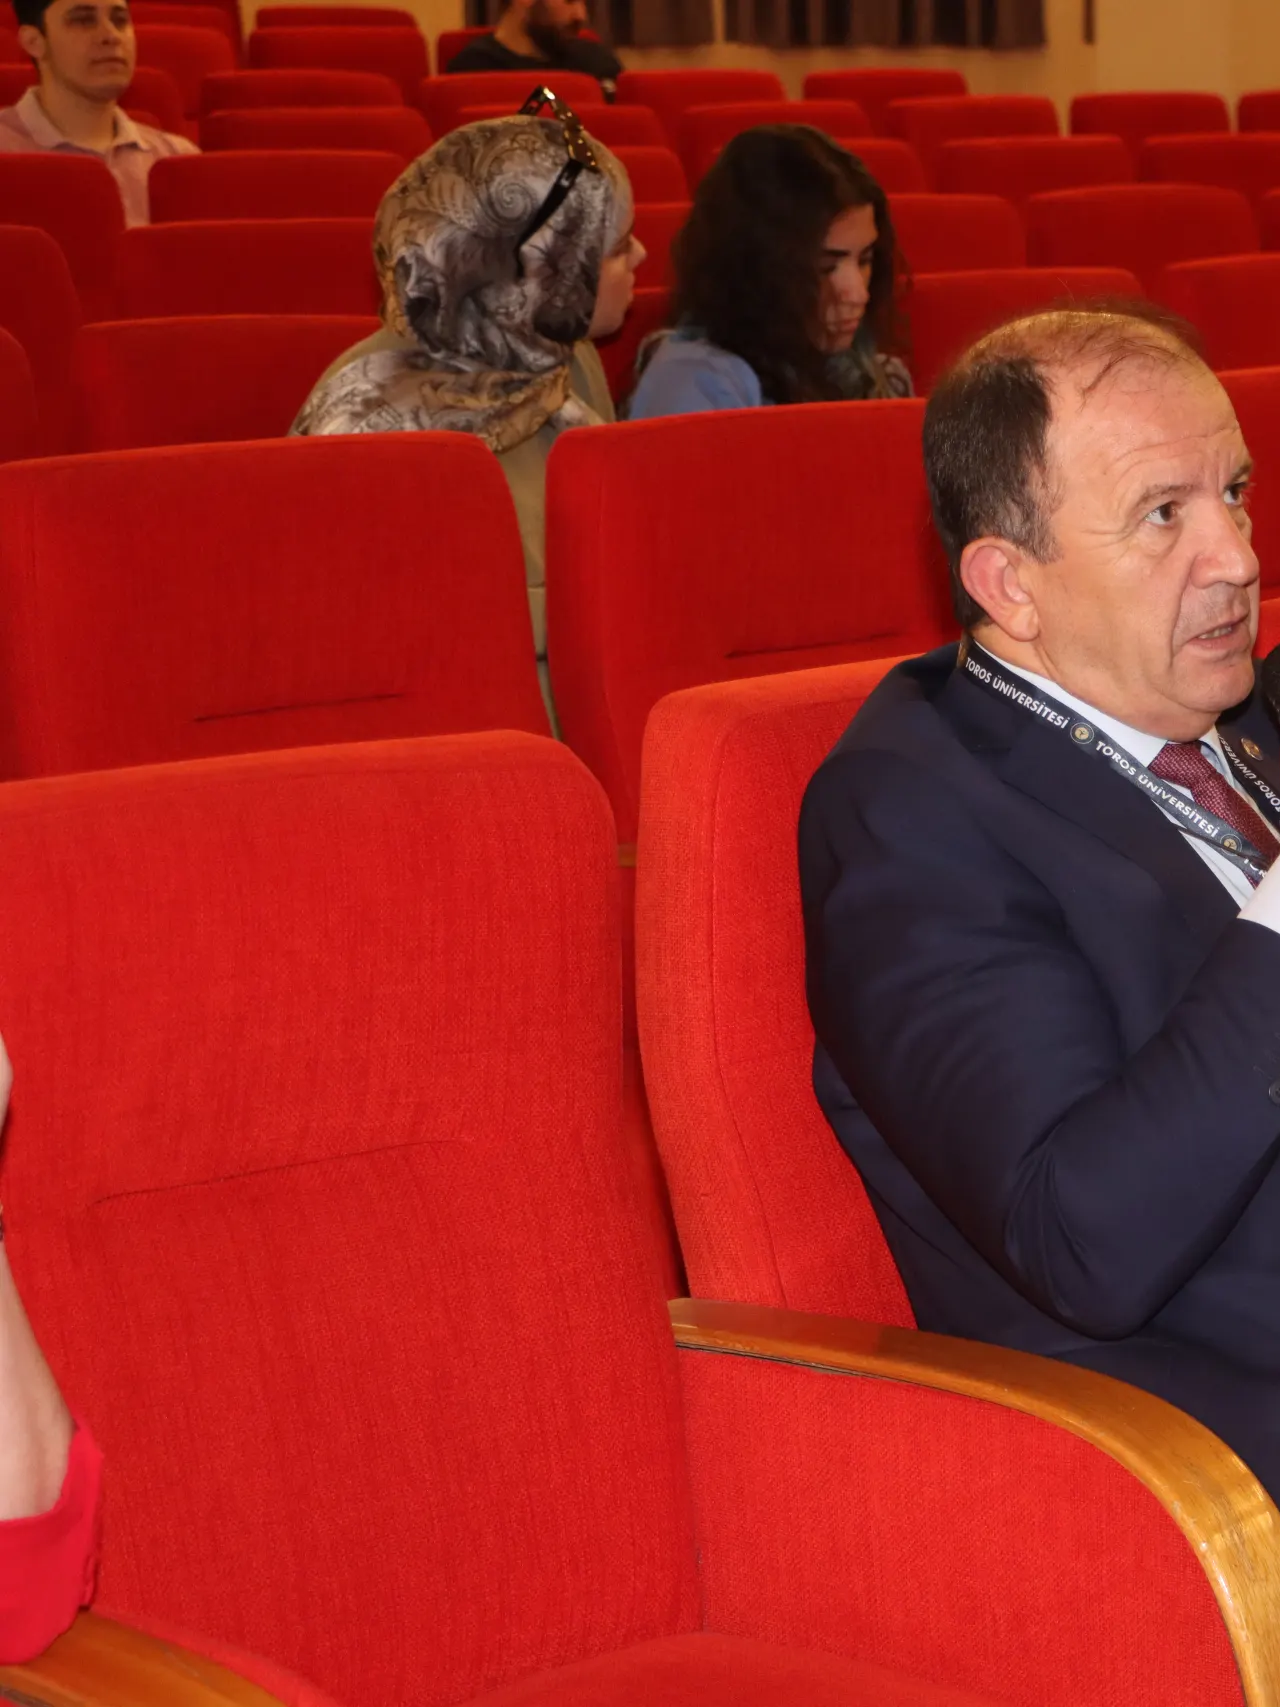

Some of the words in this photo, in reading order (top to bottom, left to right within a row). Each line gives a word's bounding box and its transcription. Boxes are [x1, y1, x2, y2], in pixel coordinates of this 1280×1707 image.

[965, 657, 992, 684] TOROS
[992, 675, 1071, 729] ÜNİVERSİTESİ
[1095, 740, 1137, 776] TOROS
[1138, 774, 1220, 838] ÜNİVERSİTESİ
